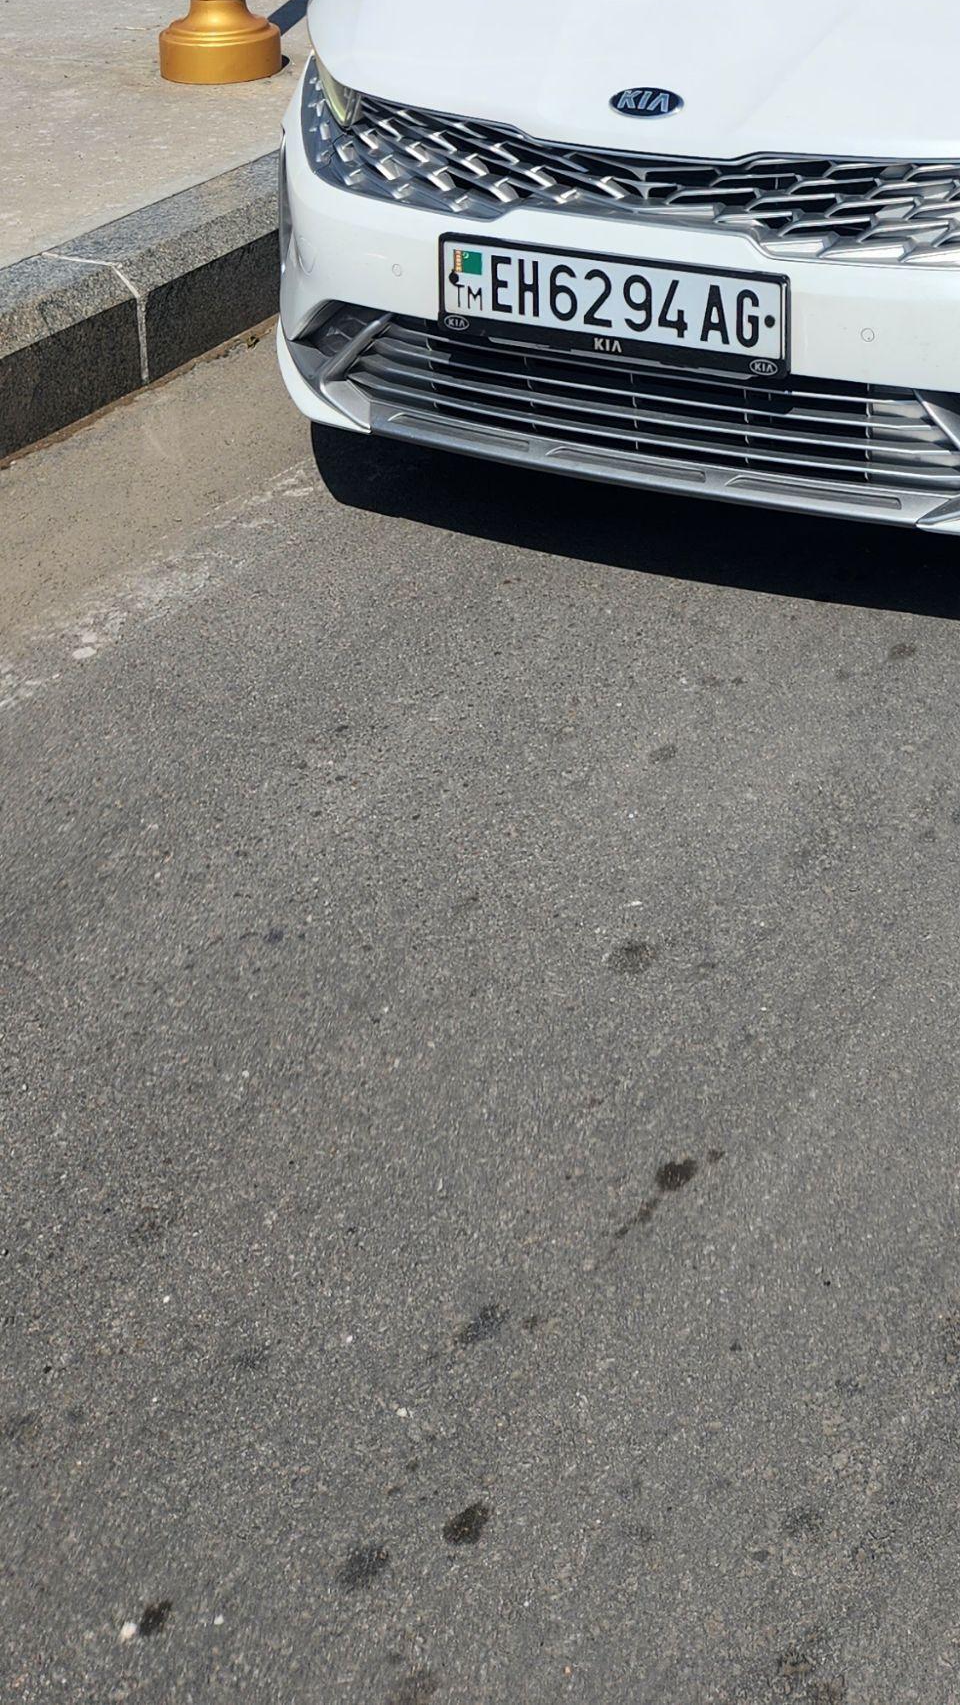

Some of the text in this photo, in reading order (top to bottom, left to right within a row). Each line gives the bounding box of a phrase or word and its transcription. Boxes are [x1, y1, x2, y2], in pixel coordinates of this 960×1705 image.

[617, 90, 670, 113] KIA
[453, 254, 760, 348] TM EH6294AG
[448, 318, 466, 328] KIA
[593, 337, 622, 353] KIA
[754, 362, 774, 373] KIA
